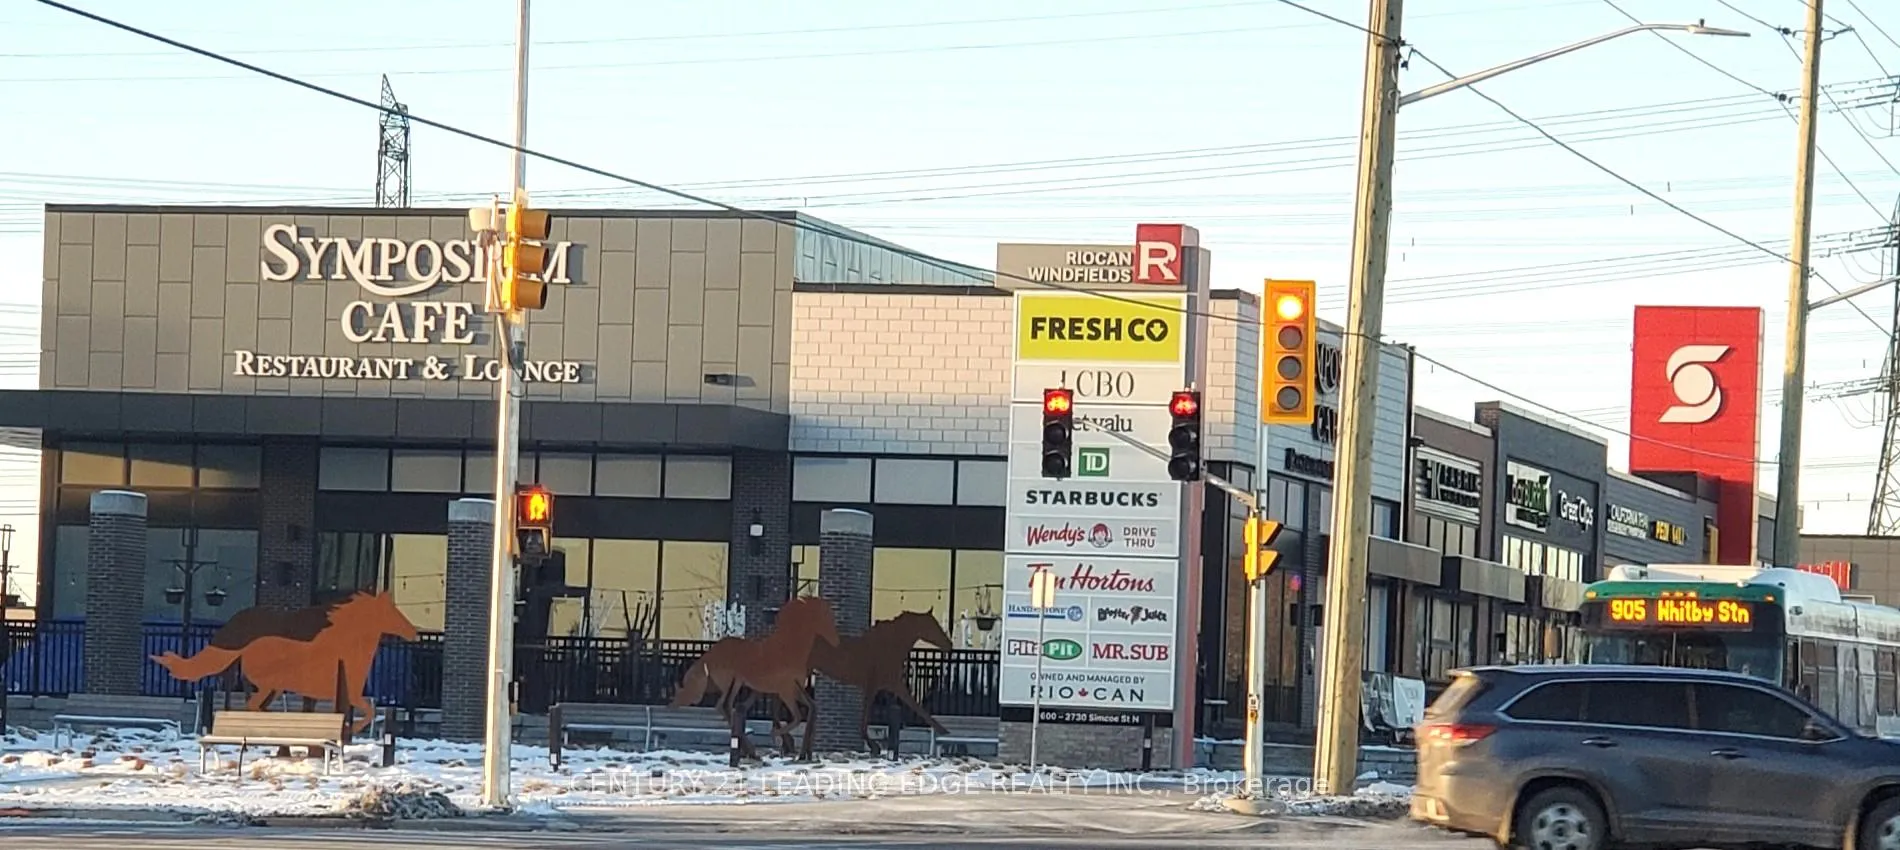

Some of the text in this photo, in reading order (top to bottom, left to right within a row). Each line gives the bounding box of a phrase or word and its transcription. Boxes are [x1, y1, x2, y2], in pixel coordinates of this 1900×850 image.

[261, 224, 571, 296] SYMPOSIM
[1066, 251, 1132, 266] RIOCAN
[1137, 241, 1178, 281] R
[1028, 267, 1132, 284] WINDFIELDS
[341, 301, 474, 344] CAFE
[234, 350, 580, 383] RESTAURANT & LONGE
[1081, 452, 1107, 472] TD
[1026, 489, 1159, 508] STARBUCKS
[1558, 489, 1579, 521] Great
[1027, 522, 1085, 547] Wendy's
[1123, 526, 1158, 537] DRIVE
[1125, 537, 1156, 549] THRU
[1070, 563, 1155, 592] Hortons
[1611, 599, 1750, 624] 905 Whitby Stn
[1066, 673, 1086, 682] AND
[1087, 674, 1132, 684] MANAGED
[1133, 675, 1146, 684] BY
[1089, 713, 1119, 723] Simcoe
[1121, 714, 1130, 724] St
[1132, 715, 1140, 724] N
